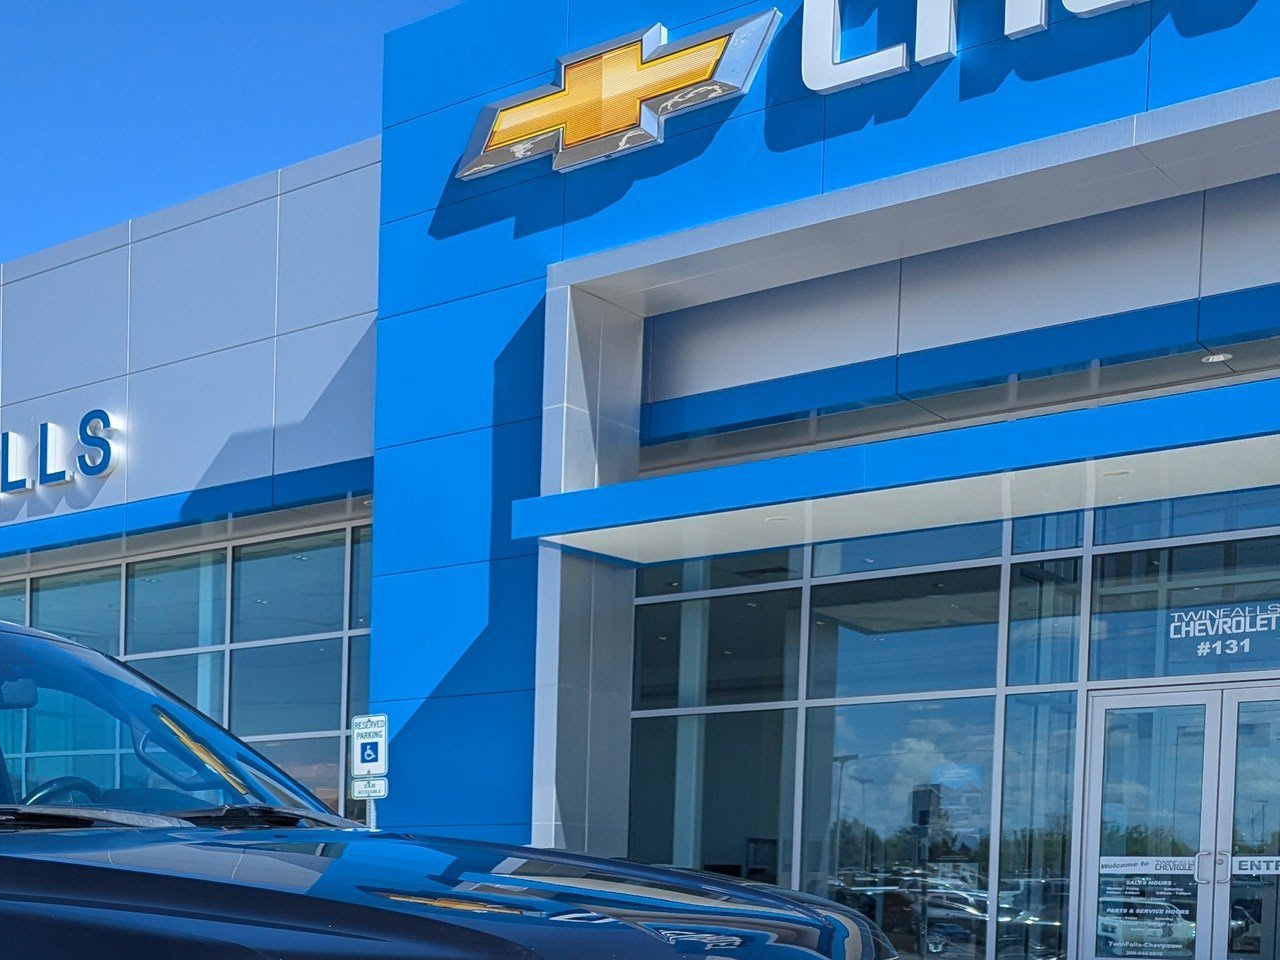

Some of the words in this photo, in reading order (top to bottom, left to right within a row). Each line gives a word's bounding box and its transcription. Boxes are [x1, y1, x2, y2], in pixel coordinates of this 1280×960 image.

[1170, 614, 1280, 638] CHEVROLET
[1197, 639, 1250, 656] #131
[354, 720, 385, 730] RESERVED
[356, 731, 383, 740] PARKING
[1101, 862, 1138, 870] Welcome
